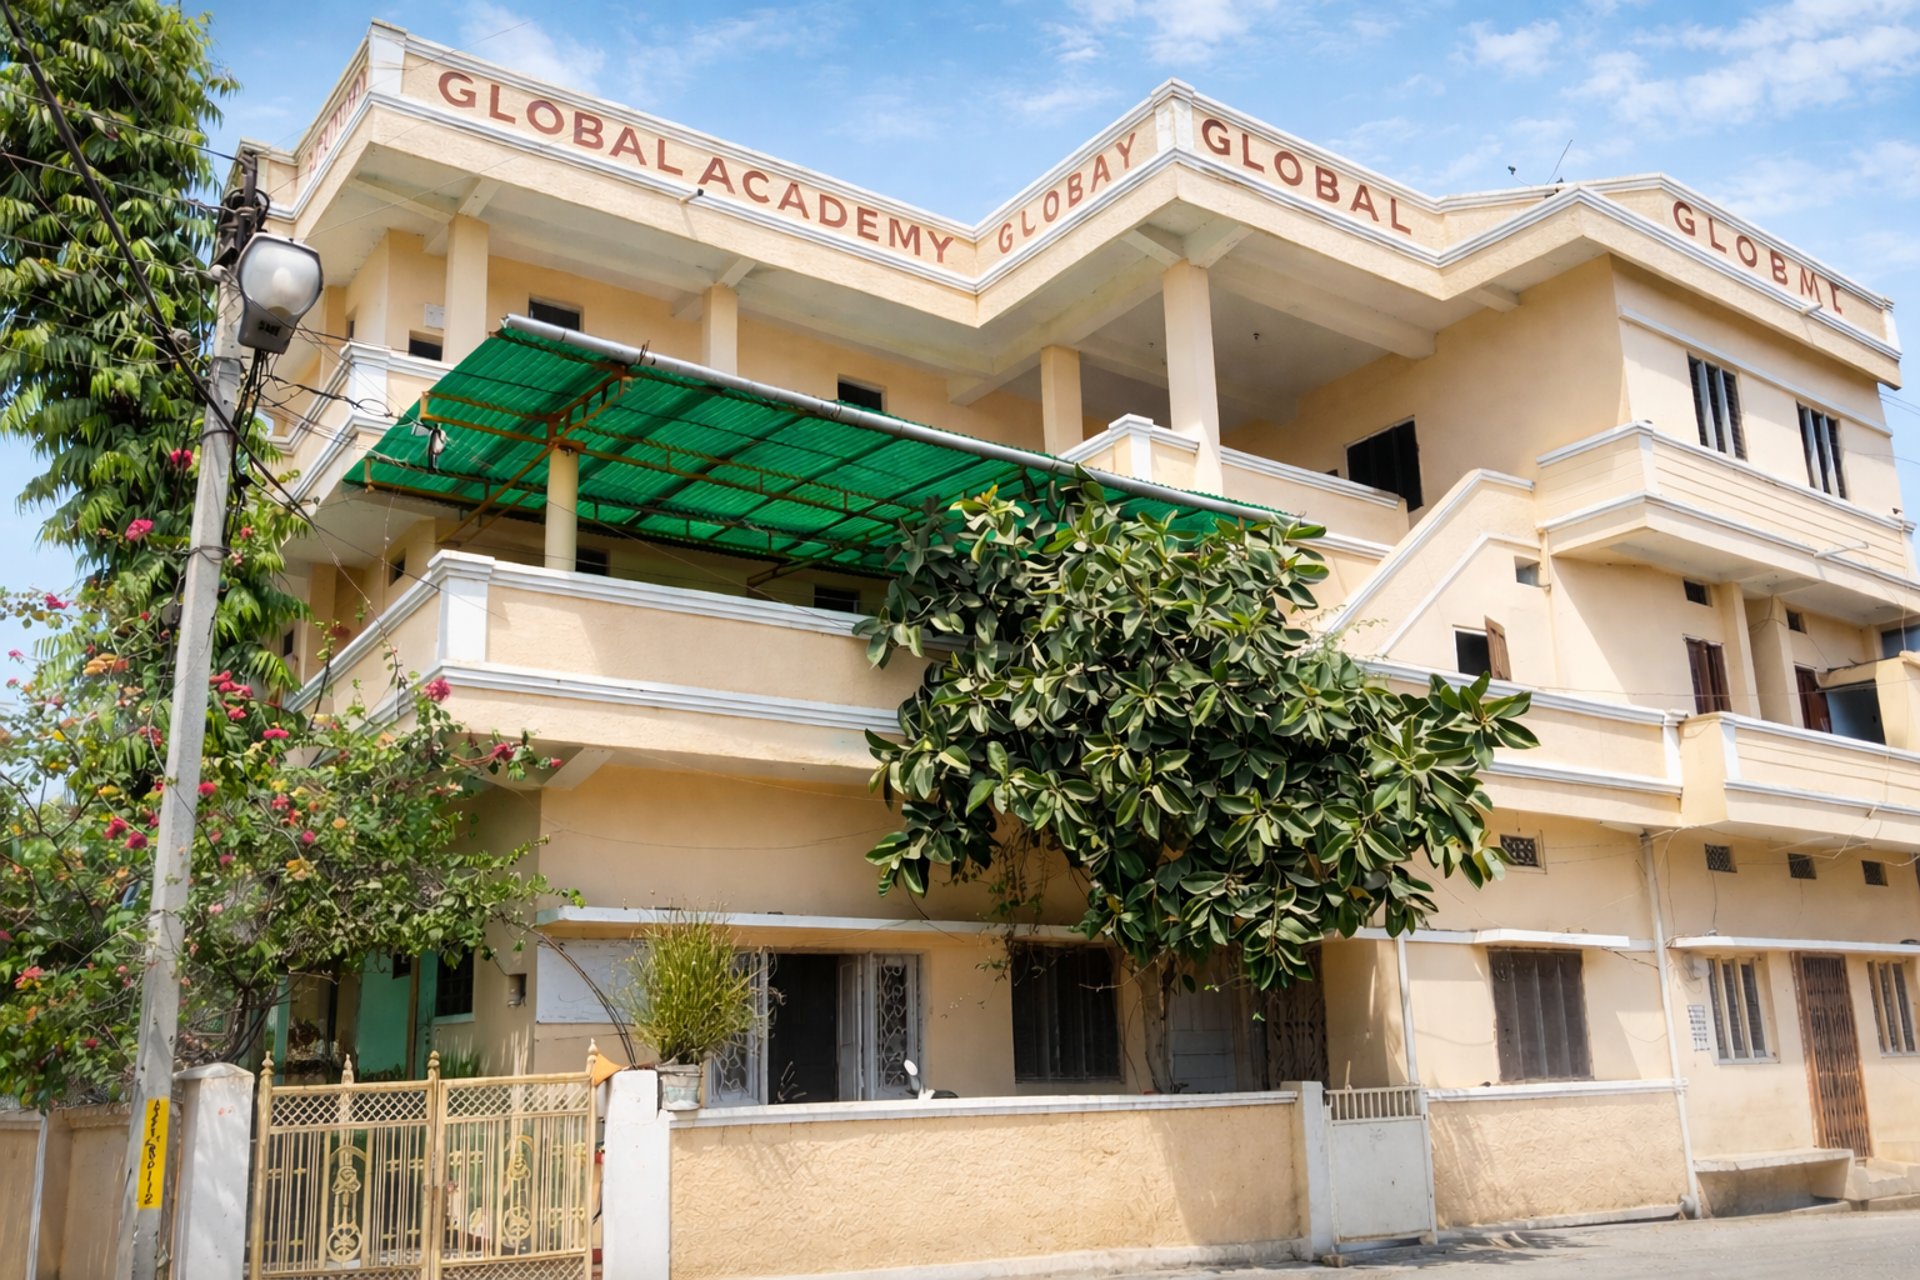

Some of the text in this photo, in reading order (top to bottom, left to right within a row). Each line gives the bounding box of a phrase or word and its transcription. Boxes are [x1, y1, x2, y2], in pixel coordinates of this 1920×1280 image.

[439, 71, 683, 177] GLOBAL
[698, 156, 954, 263] ACADEMY
[998, 132, 1137, 255] GLOBAY
[1202, 118, 1411, 235] GLOBAL
